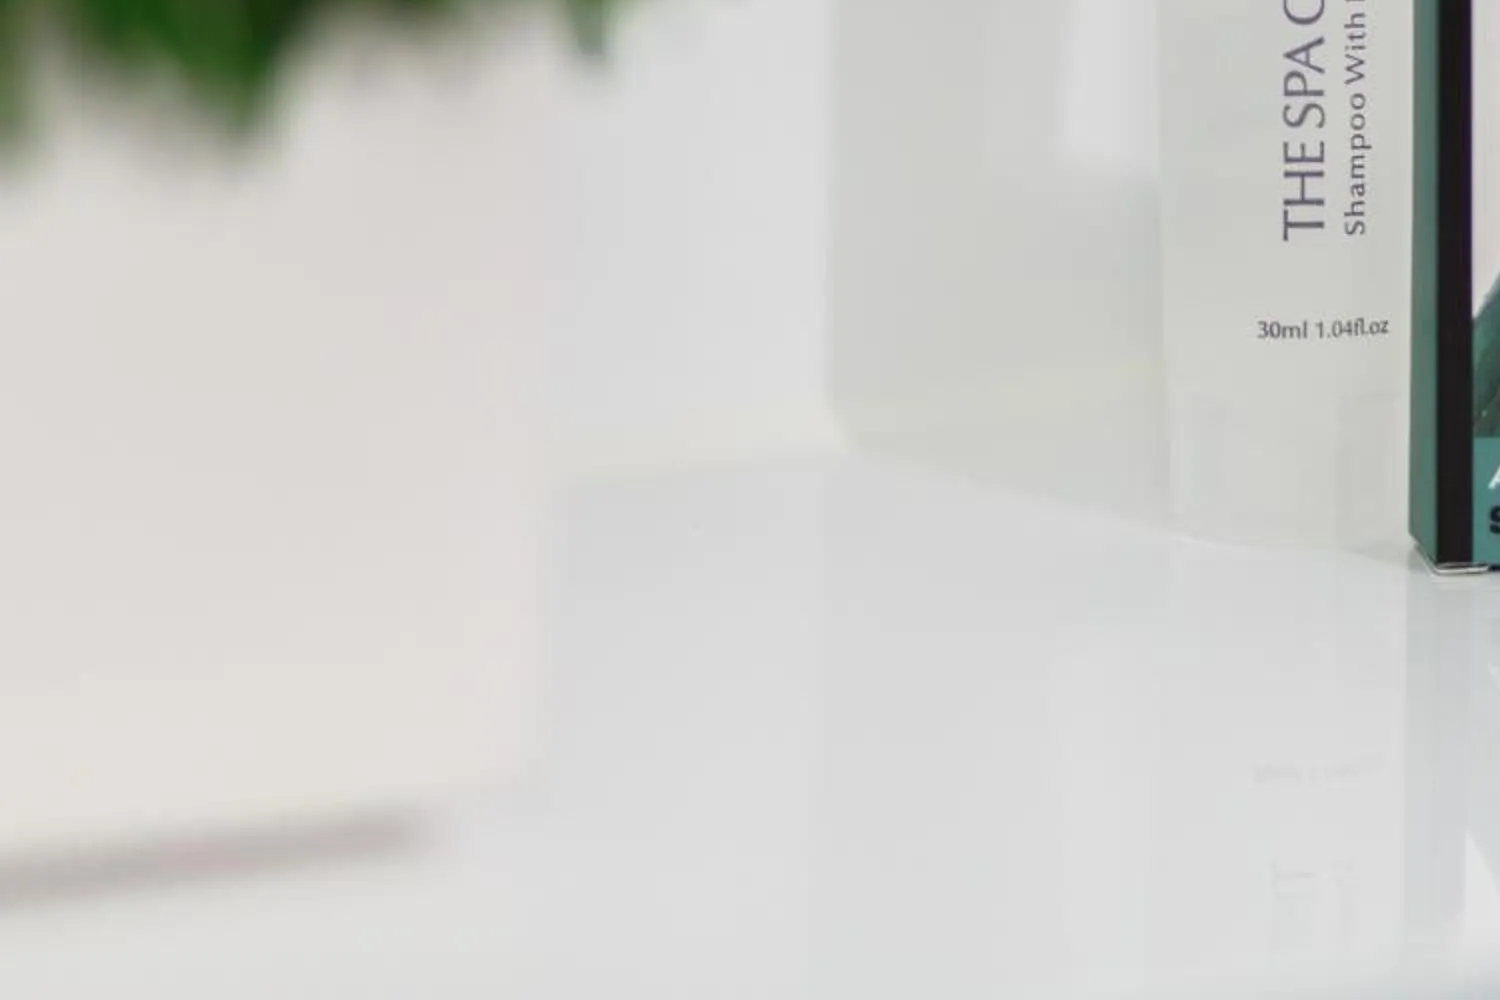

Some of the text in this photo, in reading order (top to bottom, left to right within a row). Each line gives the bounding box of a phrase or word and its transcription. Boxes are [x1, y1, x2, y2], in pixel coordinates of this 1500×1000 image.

[1282, 35, 1326, 128] SPA
[1343, 10, 1368, 85] With
[1282, 139, 1326, 241] THE
[1343, 90, 1373, 236] Shampoo
[1257, 320, 1307, 339] 30ml
